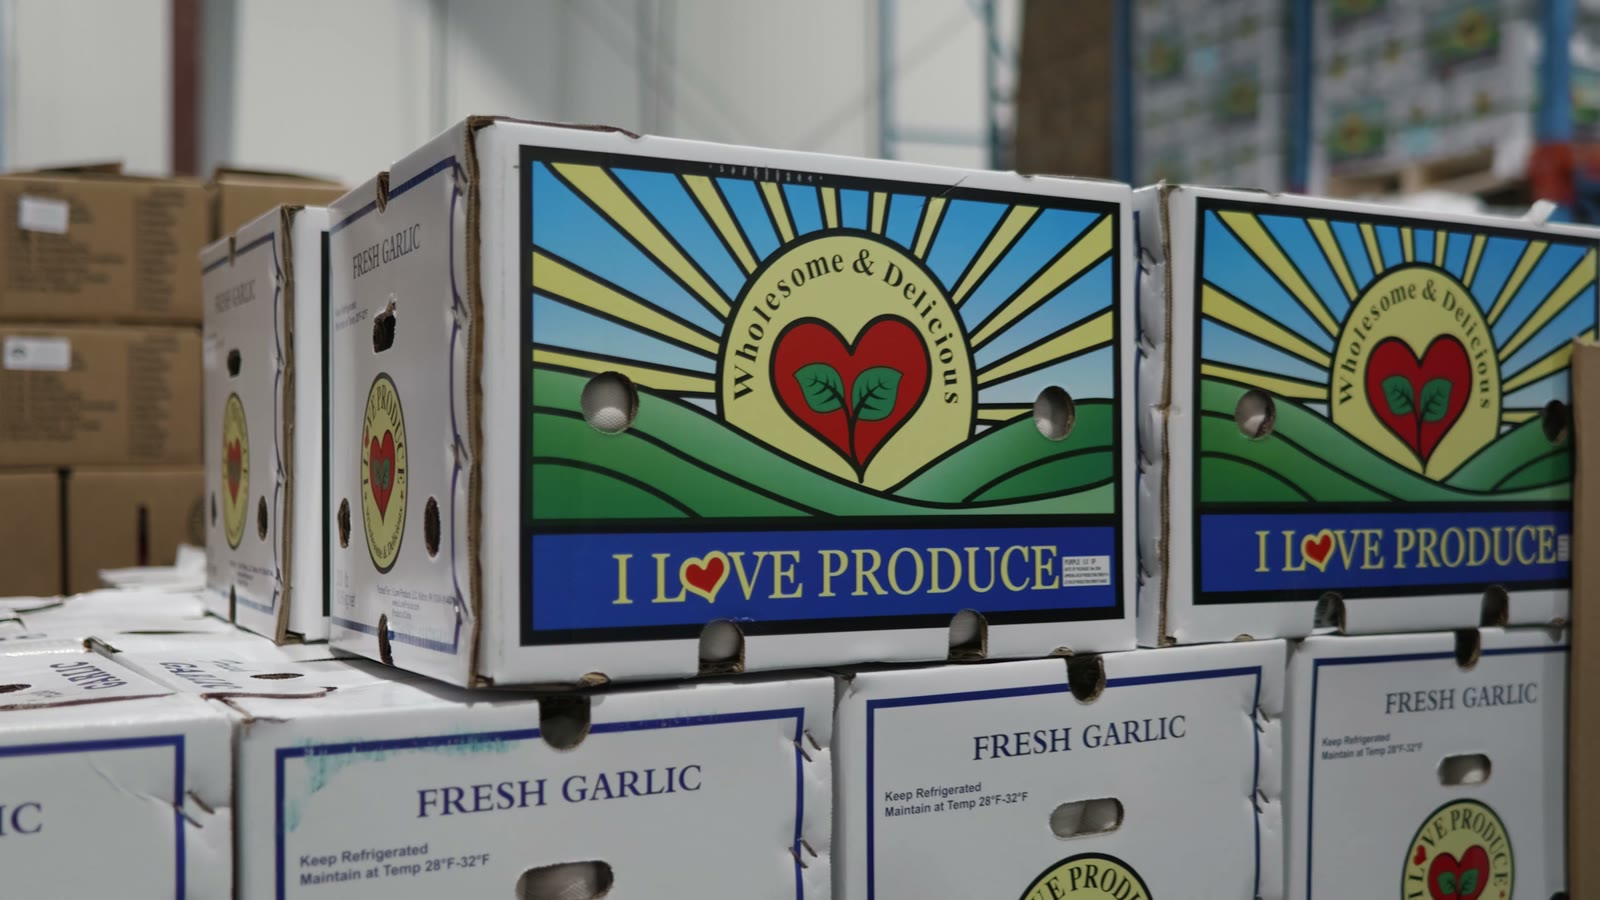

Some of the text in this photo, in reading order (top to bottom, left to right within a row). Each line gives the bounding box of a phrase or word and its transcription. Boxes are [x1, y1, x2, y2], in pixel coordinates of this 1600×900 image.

[352, 223, 421, 280] FRESH GARLIC
[733, 248, 959, 404] Wholesome & Delicious
[1338, 279, 1491, 409] Wholesome & Delicious
[1254, 530, 1270, 572] I
[1393, 524, 1556, 569] PRODUCE
[612, 553, 633, 605] I
[817, 545, 1060, 598] PRODUCE
[50, 661, 128, 690] GARLIC
[1384, 682, 1539, 715] FRESH GARLIC
[973, 715, 1187, 761] FRESH GARLIC
[417, 764, 703, 818] FRESH GARLIC
[884, 782, 982, 802] Keep Refrigerated
[884, 805, 931, 817] Maintain
[933, 802, 945, 812] at
[946, 799, 976, 811] Temp
[300, 843, 429, 868] Keep Refrigerated
[1450, 808, 1508, 887] PRODUCE
[300, 869, 361, 886] Maintain
[365, 867, 379, 879] at
[383, 862, 421, 877] Temp
